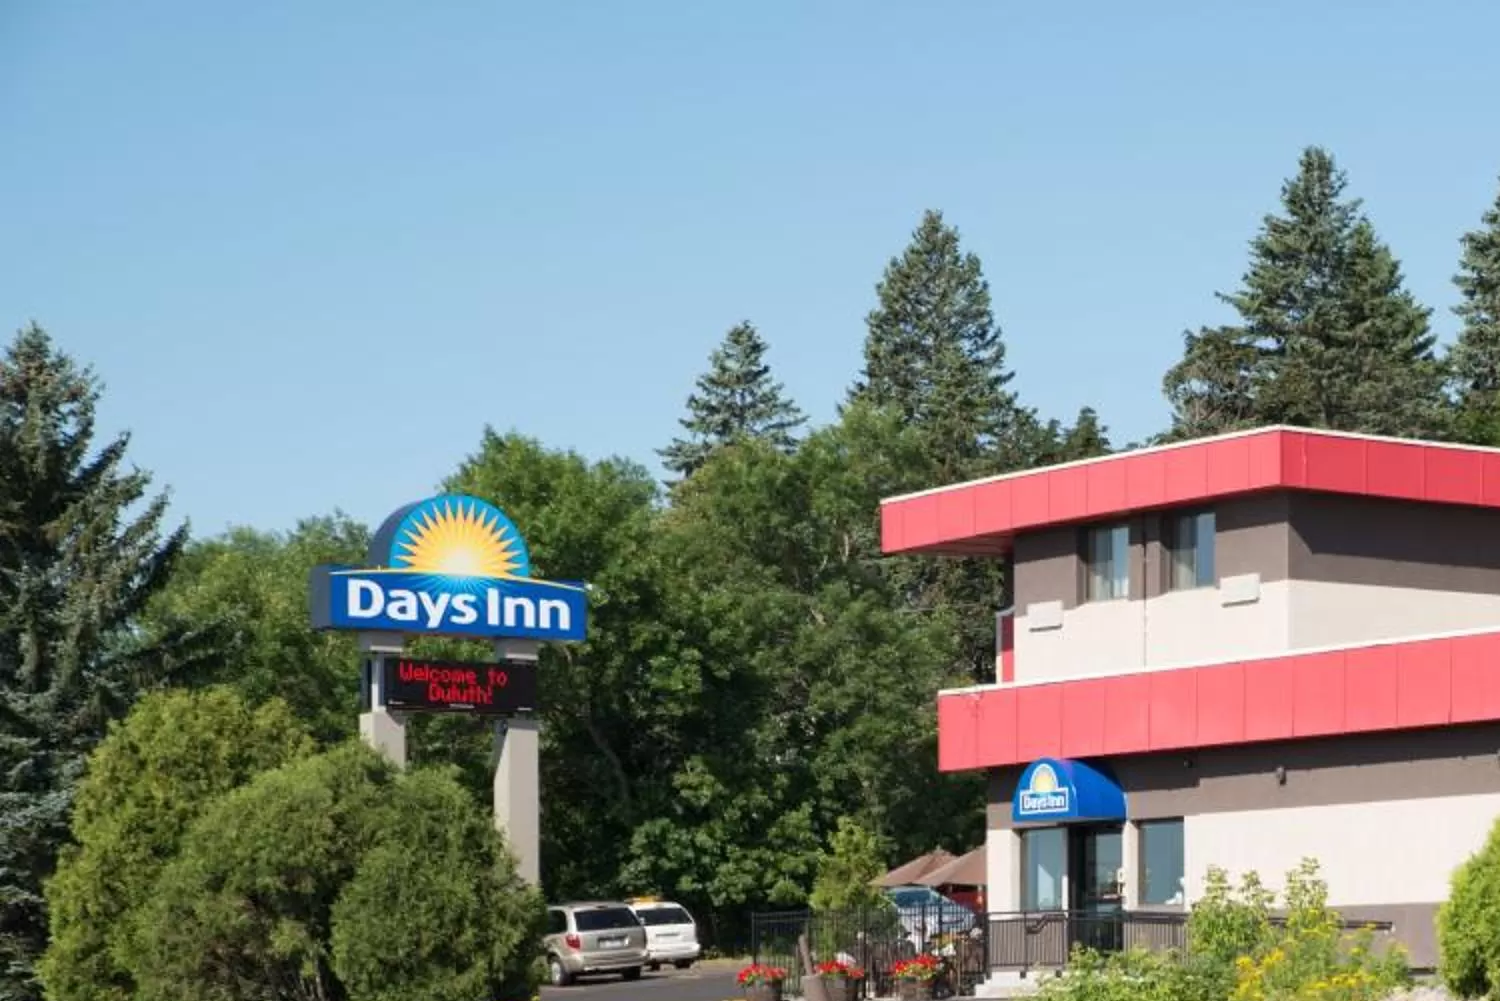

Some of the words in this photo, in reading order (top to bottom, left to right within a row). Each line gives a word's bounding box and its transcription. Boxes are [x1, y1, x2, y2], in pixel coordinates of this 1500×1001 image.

[347, 578, 477, 629] Days
[487, 588, 571, 631] Inn
[399, 661, 477, 684] Welcome
[488, 667, 508, 685] to
[428, 684, 493, 705] Duluth!
